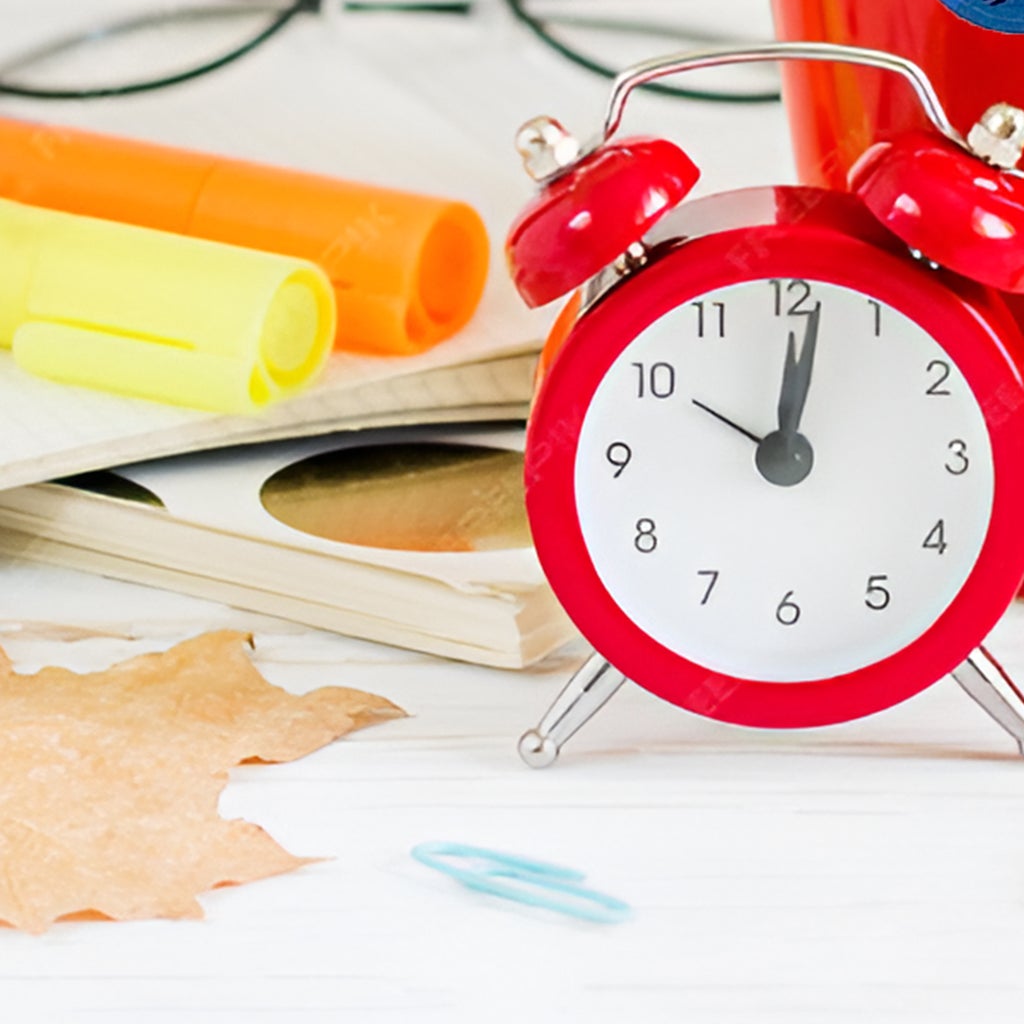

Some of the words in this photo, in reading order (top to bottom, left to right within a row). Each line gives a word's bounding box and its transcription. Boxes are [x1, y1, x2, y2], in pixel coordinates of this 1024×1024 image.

[768, 278, 813, 318] 12
[690, 300, 725, 338] 11
[867, 298, 882, 337] 1
[631, 361, 676, 399] 10
[925, 359, 952, 396] 2
[606, 441, 632, 479] 9
[944, 438, 970, 476] 3
[633, 517, 659, 554] 8
[921, 519, 947, 556] 4
[697, 569, 720, 606] 7
[864, 574, 891, 612] 5
[775, 589, 801, 627] 6
